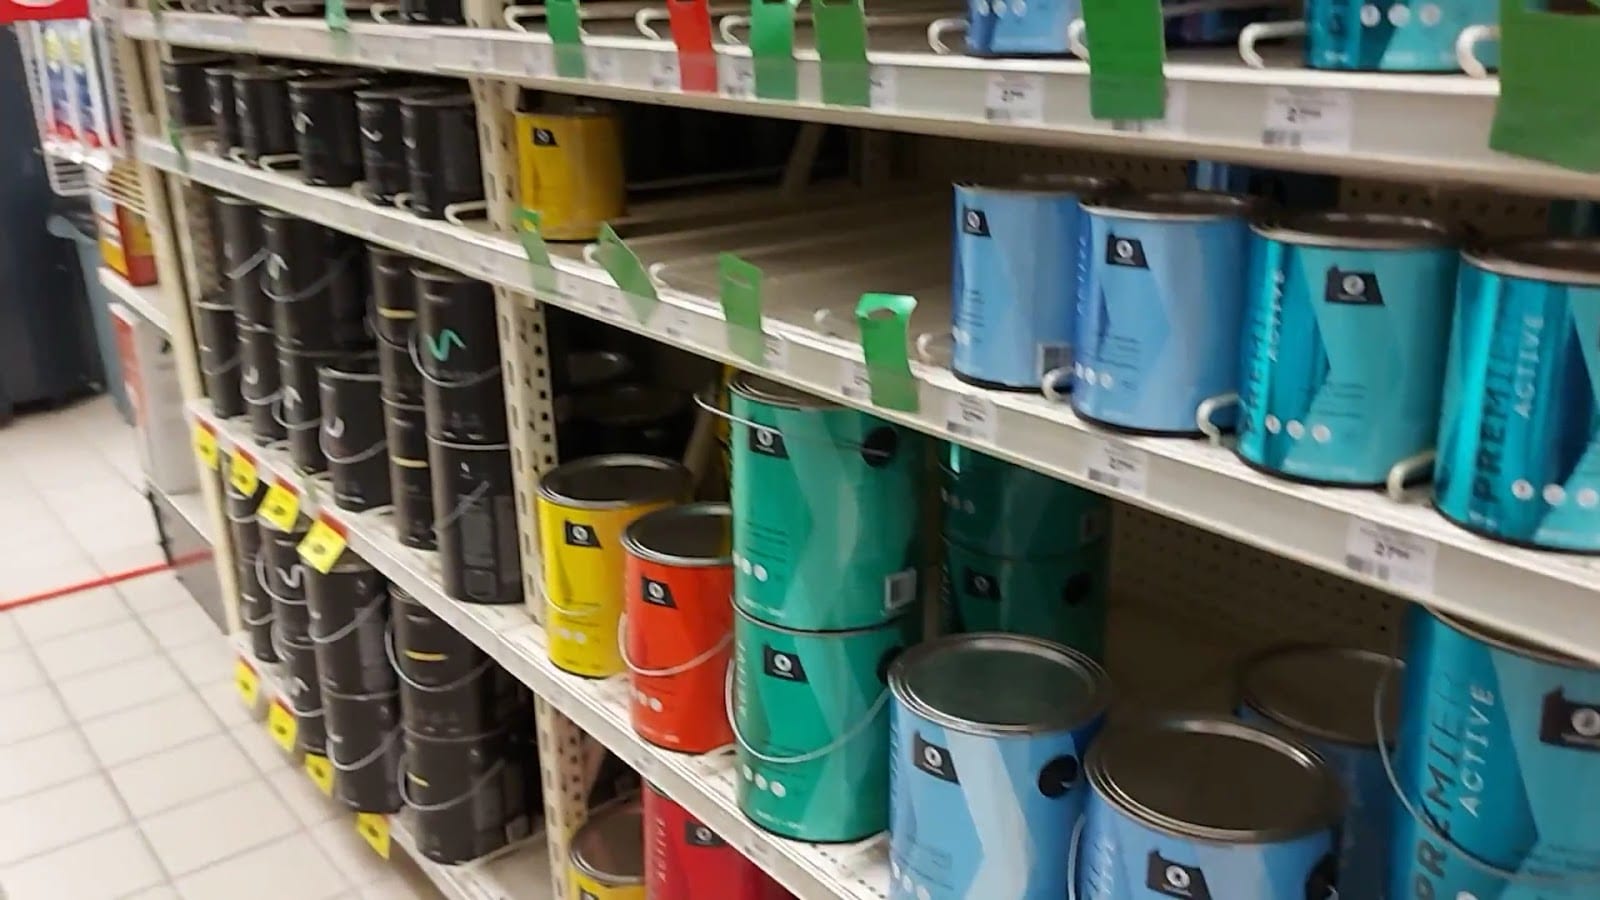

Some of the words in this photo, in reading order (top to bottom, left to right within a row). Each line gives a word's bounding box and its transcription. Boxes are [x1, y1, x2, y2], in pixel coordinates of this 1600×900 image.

[1474, 338, 1513, 504] PREMI
[1513, 313, 1545, 420] ACTIVE
[1459, 682, 1496, 818] ACTIVE
